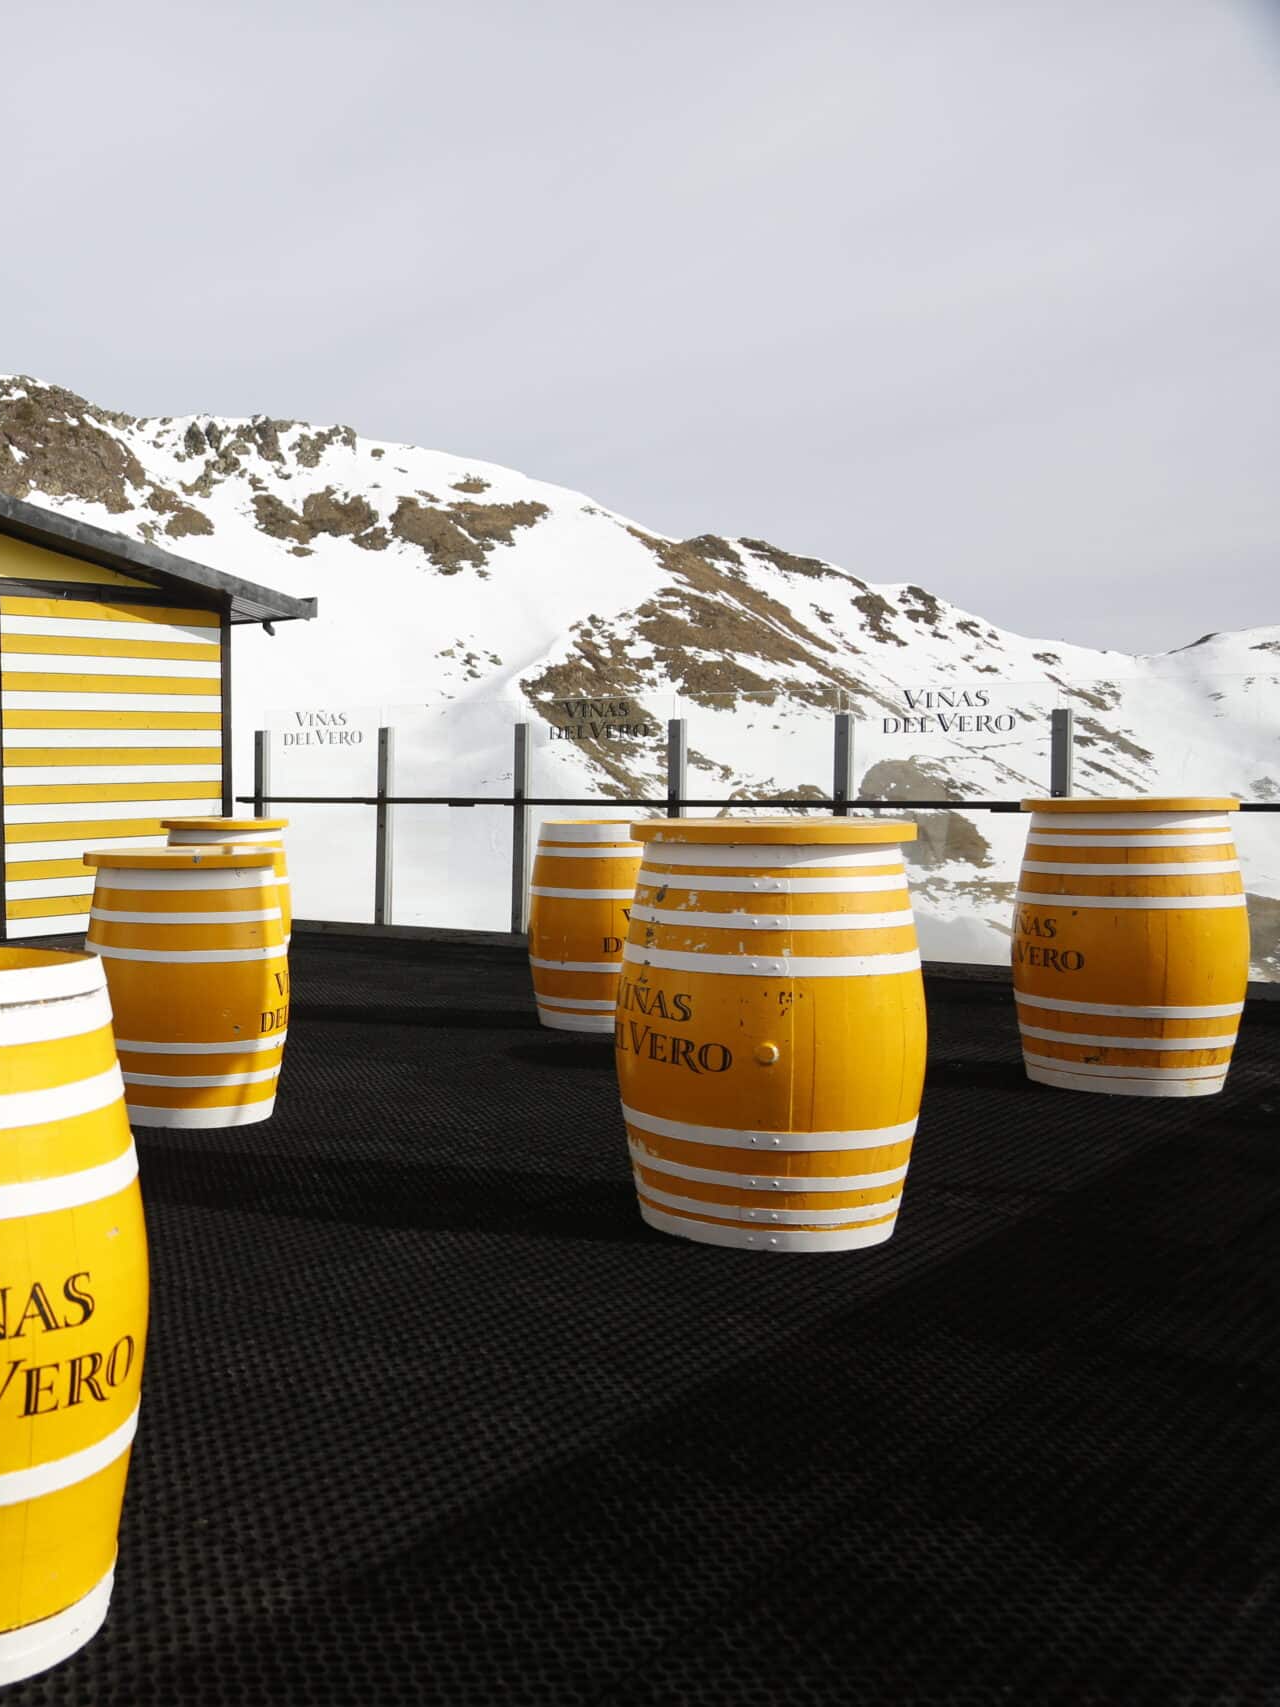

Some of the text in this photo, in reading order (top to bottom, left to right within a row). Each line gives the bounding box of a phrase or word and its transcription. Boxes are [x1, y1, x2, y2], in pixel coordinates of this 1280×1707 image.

[903, 686, 990, 709] VIÑAS
[295, 710, 347, 727] VIÑAS
[883, 712, 1016, 735] DEL VERO
[283, 729, 363, 746] DEL VERO
[629, 1019, 733, 1075] VERO
